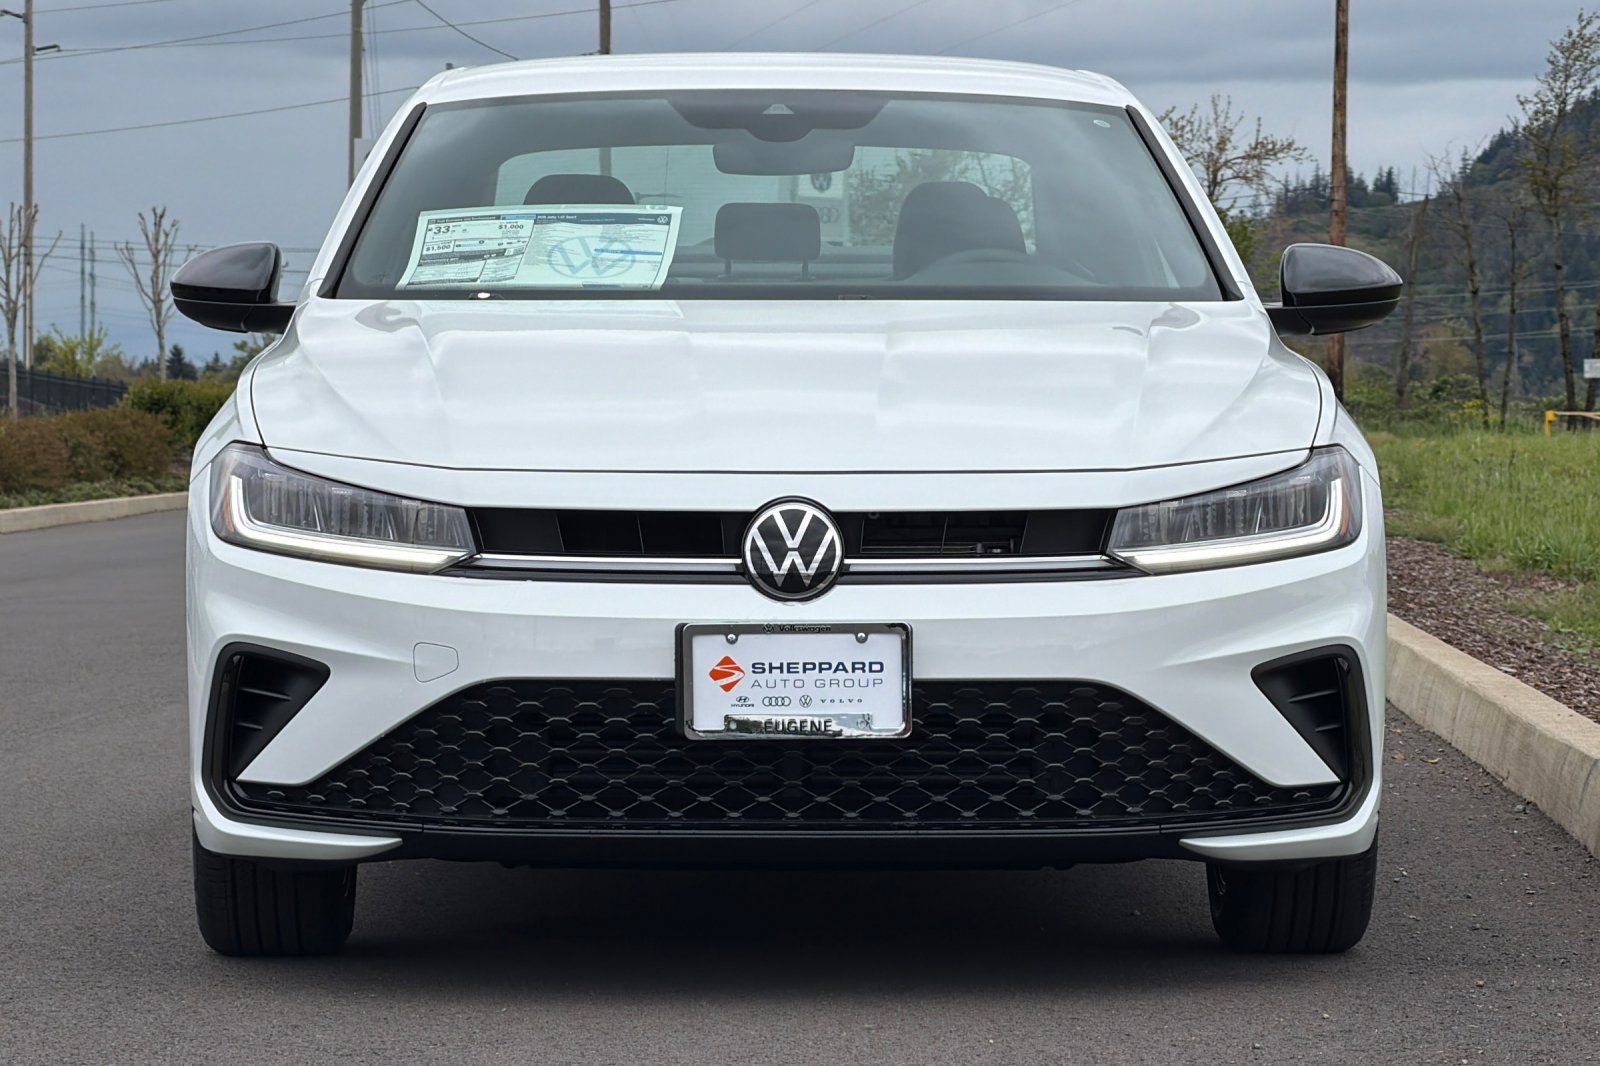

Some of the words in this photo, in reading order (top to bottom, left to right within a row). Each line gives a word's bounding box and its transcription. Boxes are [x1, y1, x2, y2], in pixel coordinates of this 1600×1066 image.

[433, 225, 451, 235] 33
[425, 244, 451, 252] $1,500
[748, 504, 839, 592] VW
[779, 624, 831, 634] Volkswagen
[751, 661, 885, 674] SHEPPARD
[751, 678, 805, 689] AUTO
[814, 678, 884, 689] GROUP
[763, 718, 833, 732] EUGENE
